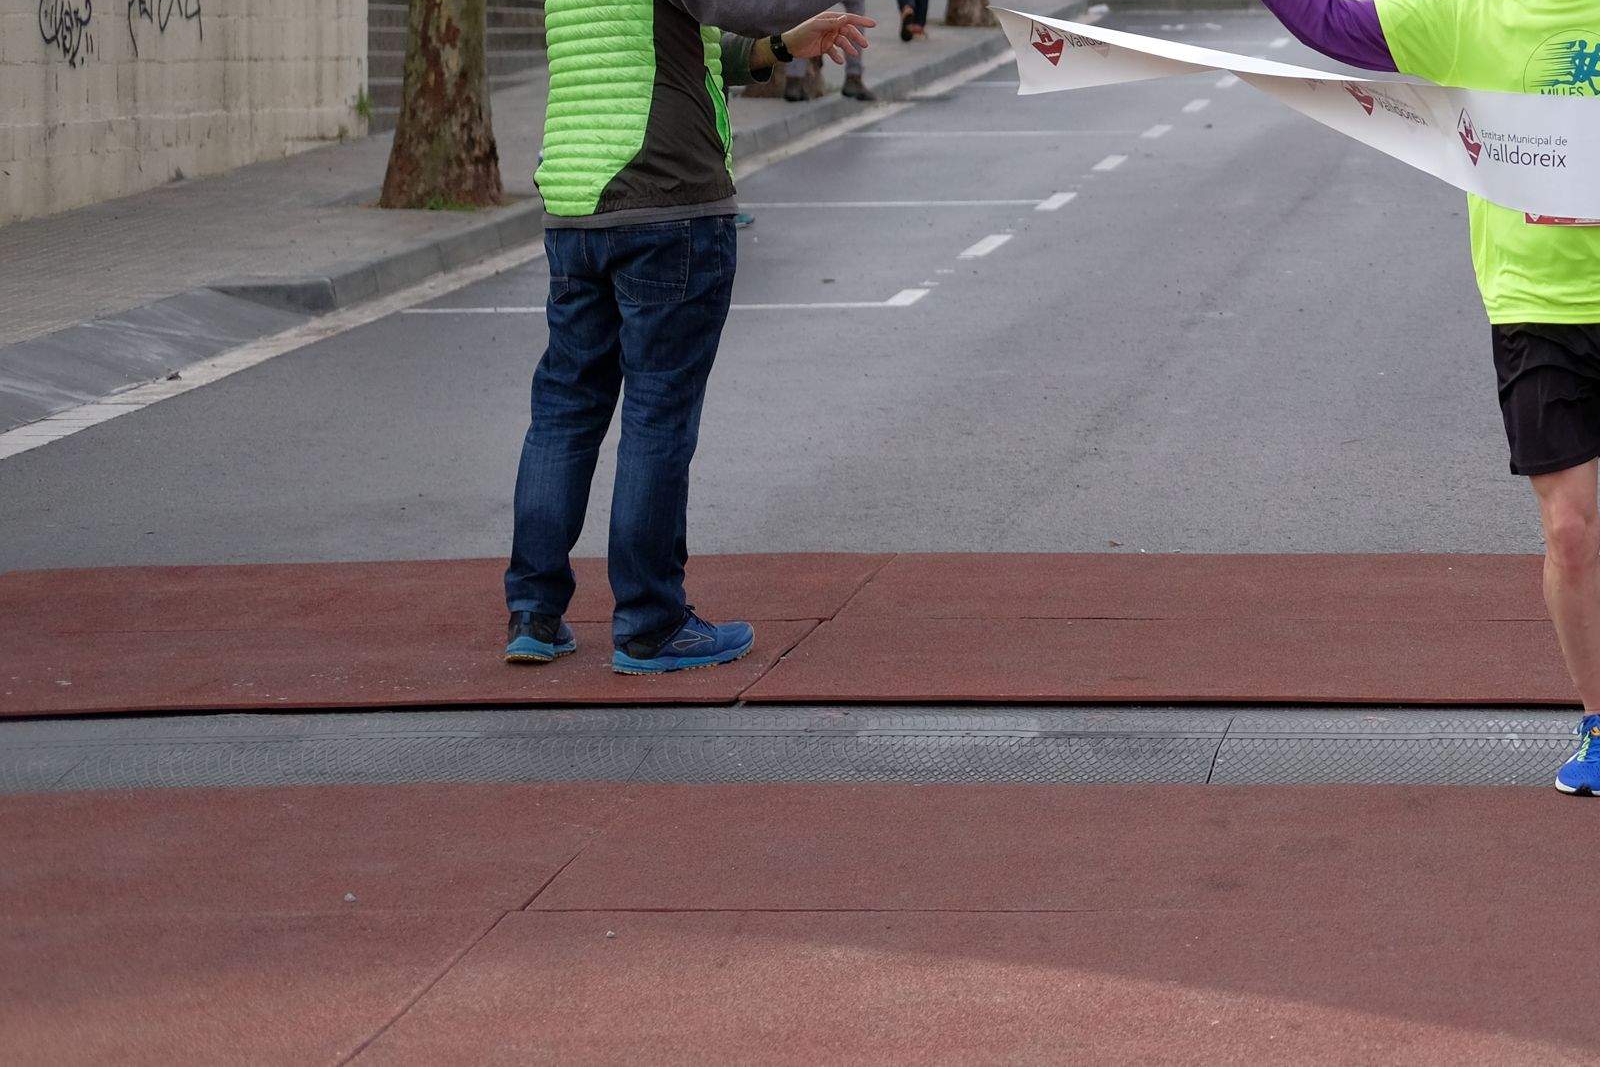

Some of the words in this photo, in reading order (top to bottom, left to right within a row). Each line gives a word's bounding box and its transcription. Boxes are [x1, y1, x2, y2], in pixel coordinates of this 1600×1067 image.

[1480, 129, 1505, 142] Entitat
[1507, 134, 1552, 147] Municipal
[1554, 136, 1568, 147] de
[1482, 141, 1567, 168] Valldoreix
